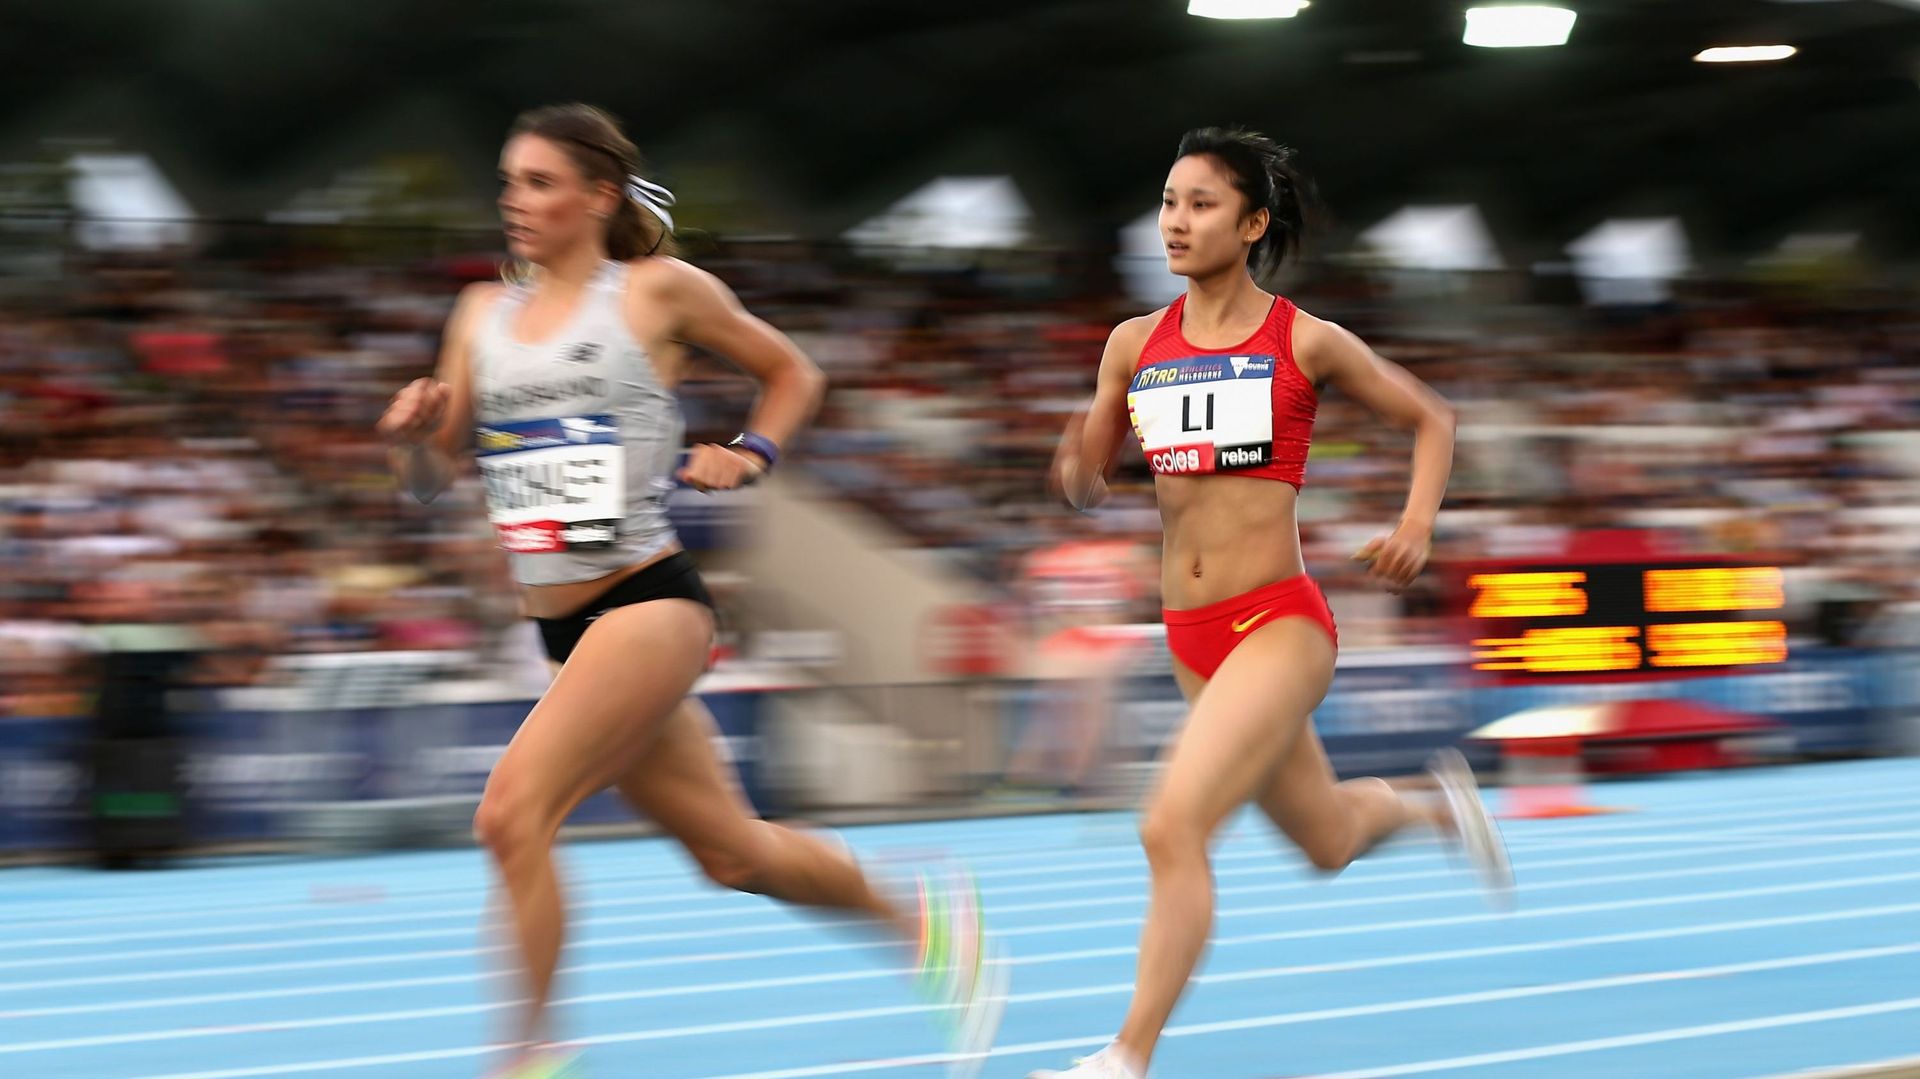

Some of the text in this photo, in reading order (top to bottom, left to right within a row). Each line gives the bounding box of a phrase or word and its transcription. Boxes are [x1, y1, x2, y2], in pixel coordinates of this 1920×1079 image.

[1179, 371, 1222, 382] MELBOURNE
[1180, 363, 1222, 373] ATHLETICS
[1182, 393, 1214, 432] LI
[1152, 448, 1199, 473] coles
[1221, 447, 1262, 466] rebel
